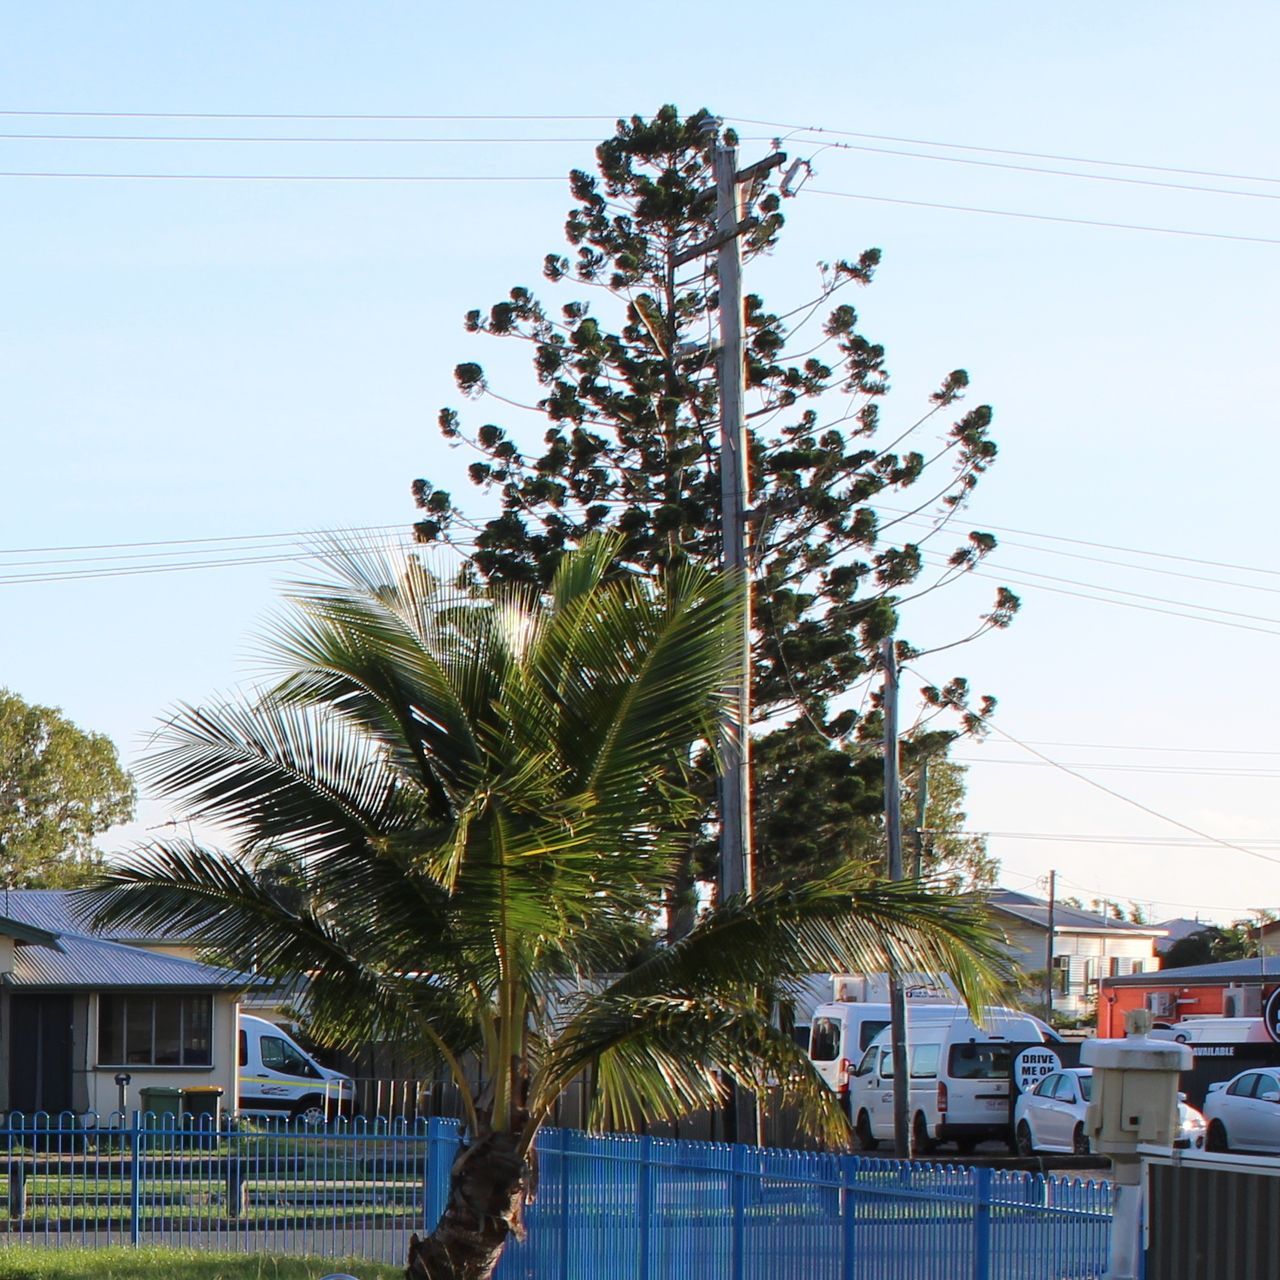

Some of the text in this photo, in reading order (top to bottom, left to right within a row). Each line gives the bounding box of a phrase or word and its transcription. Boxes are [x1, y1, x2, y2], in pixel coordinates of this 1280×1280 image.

[1192, 1047, 1234, 1056] AVAILABLE
[1022, 1055, 1054, 1063] DRIVE
[1022, 1066, 1037, 1075] ME
